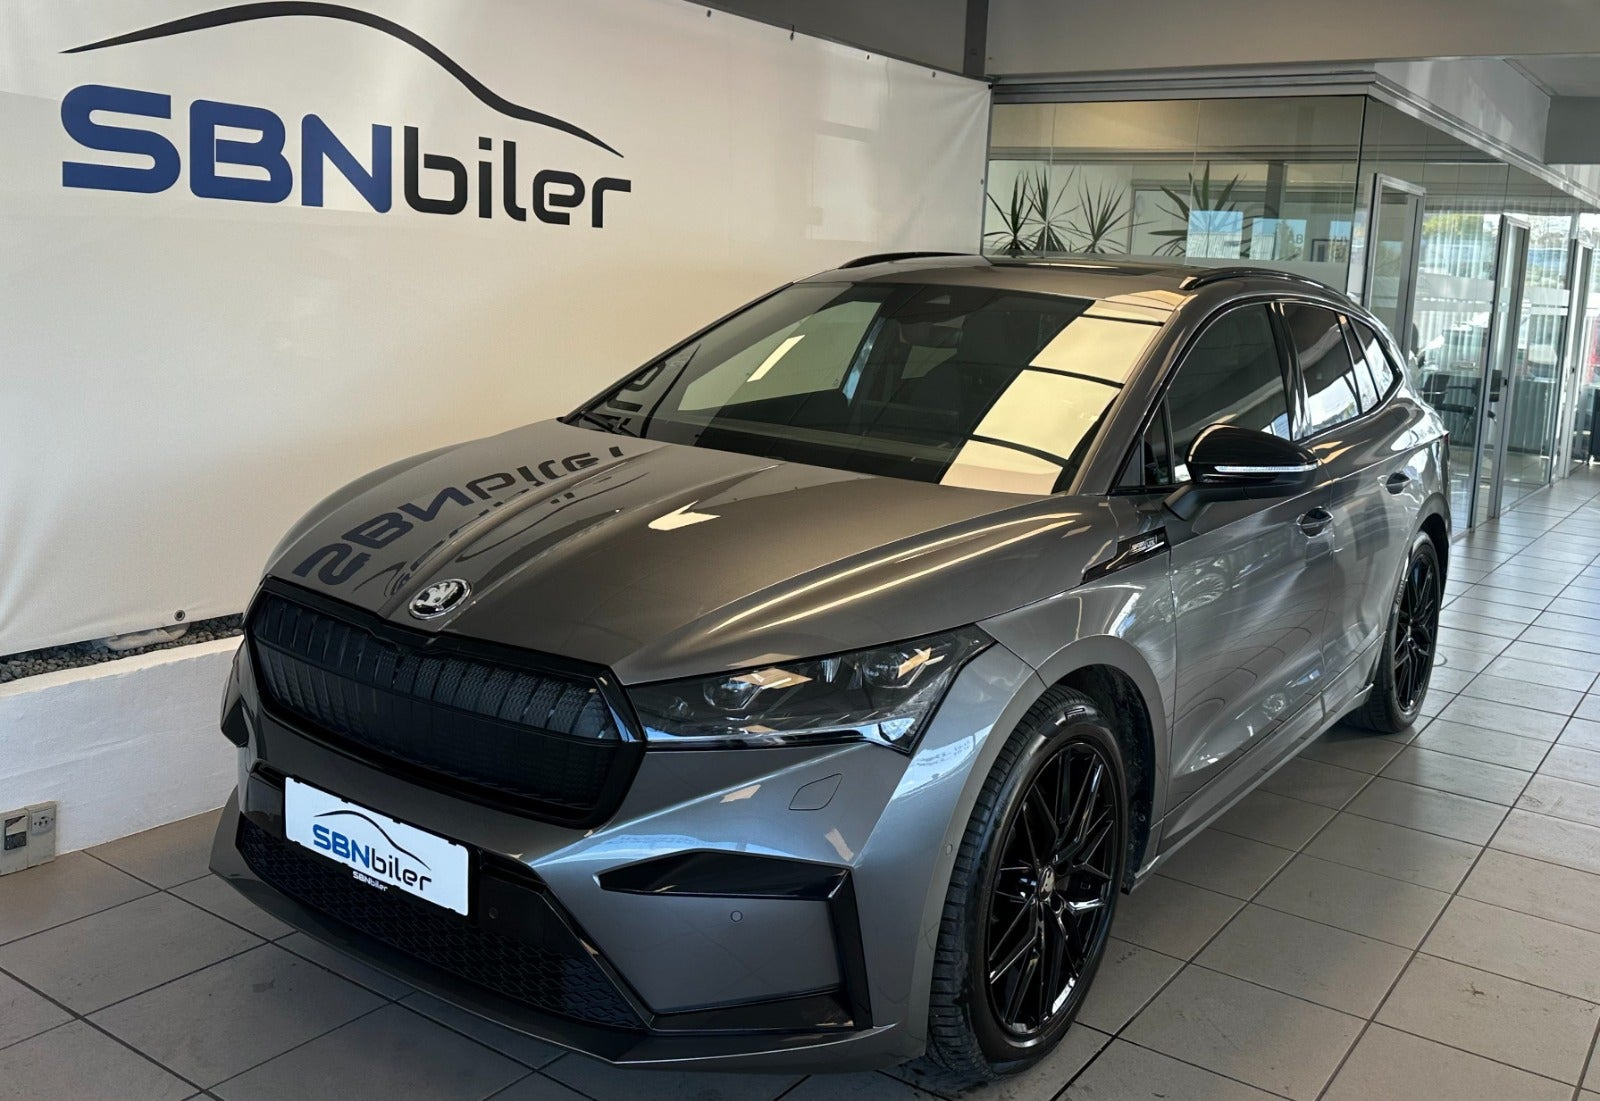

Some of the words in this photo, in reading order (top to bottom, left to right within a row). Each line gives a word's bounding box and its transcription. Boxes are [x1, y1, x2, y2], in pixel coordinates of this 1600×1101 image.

[60, 83, 631, 229] SBNbiler
[312, 824, 432, 890] SBNbiler
[352, 870, 388, 891] SBNbiler
